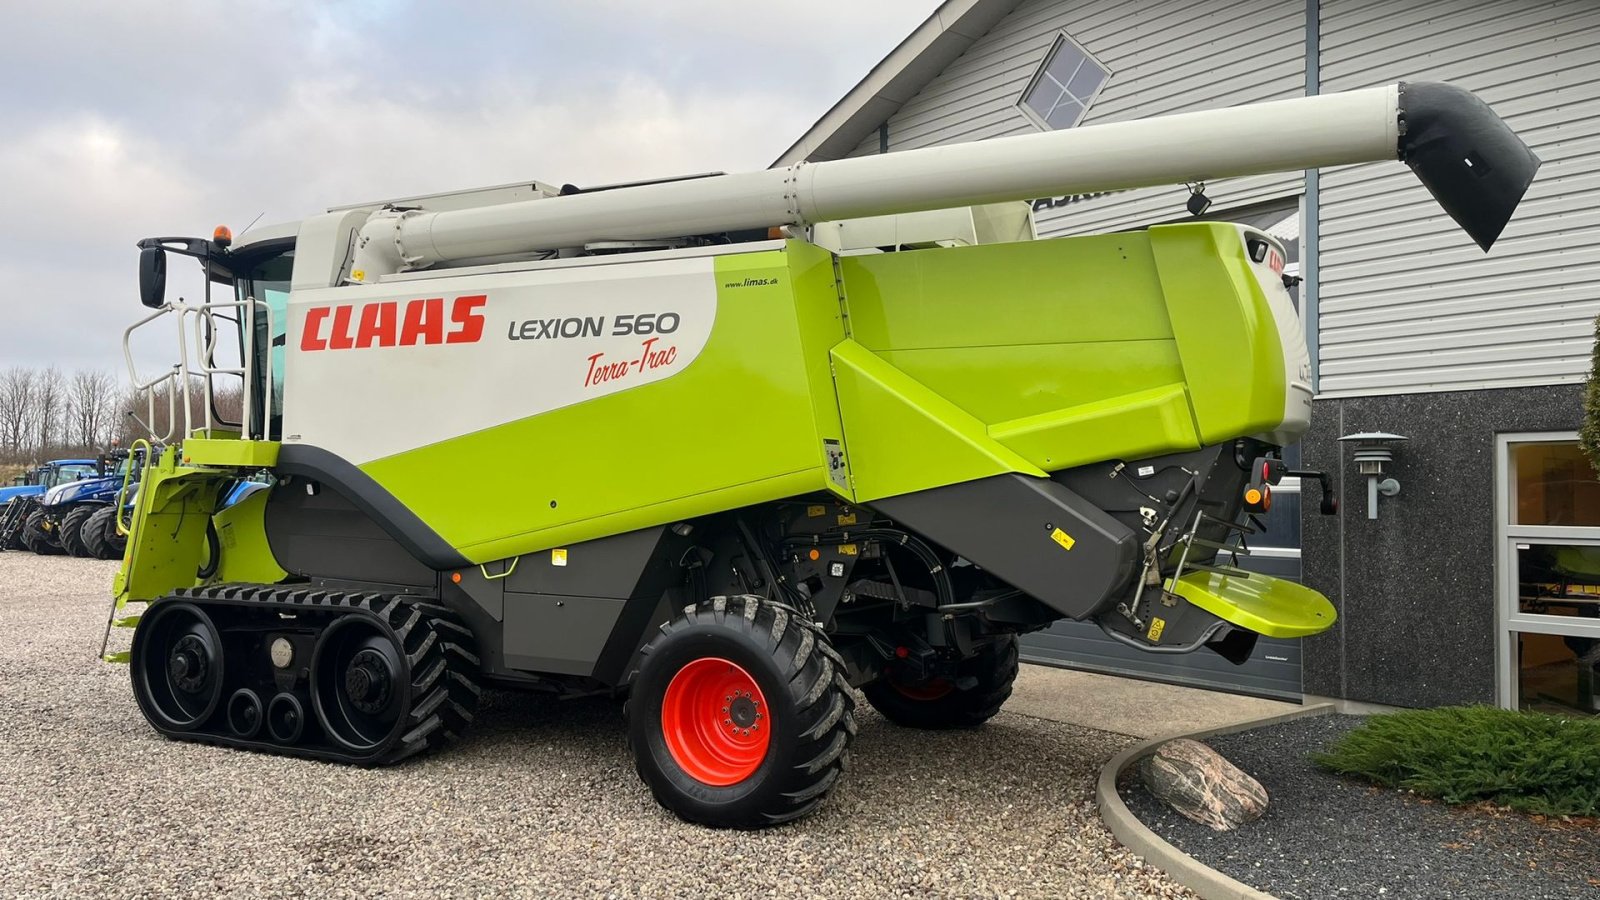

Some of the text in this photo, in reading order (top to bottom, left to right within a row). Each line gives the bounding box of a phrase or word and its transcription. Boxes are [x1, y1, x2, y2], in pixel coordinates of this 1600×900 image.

[725, 278, 778, 288] www.limas.dk
[300, 295, 487, 351] CLAAS
[508, 312, 681, 340] LEXION 560
[584, 337, 677, 387] Terra-Trac
